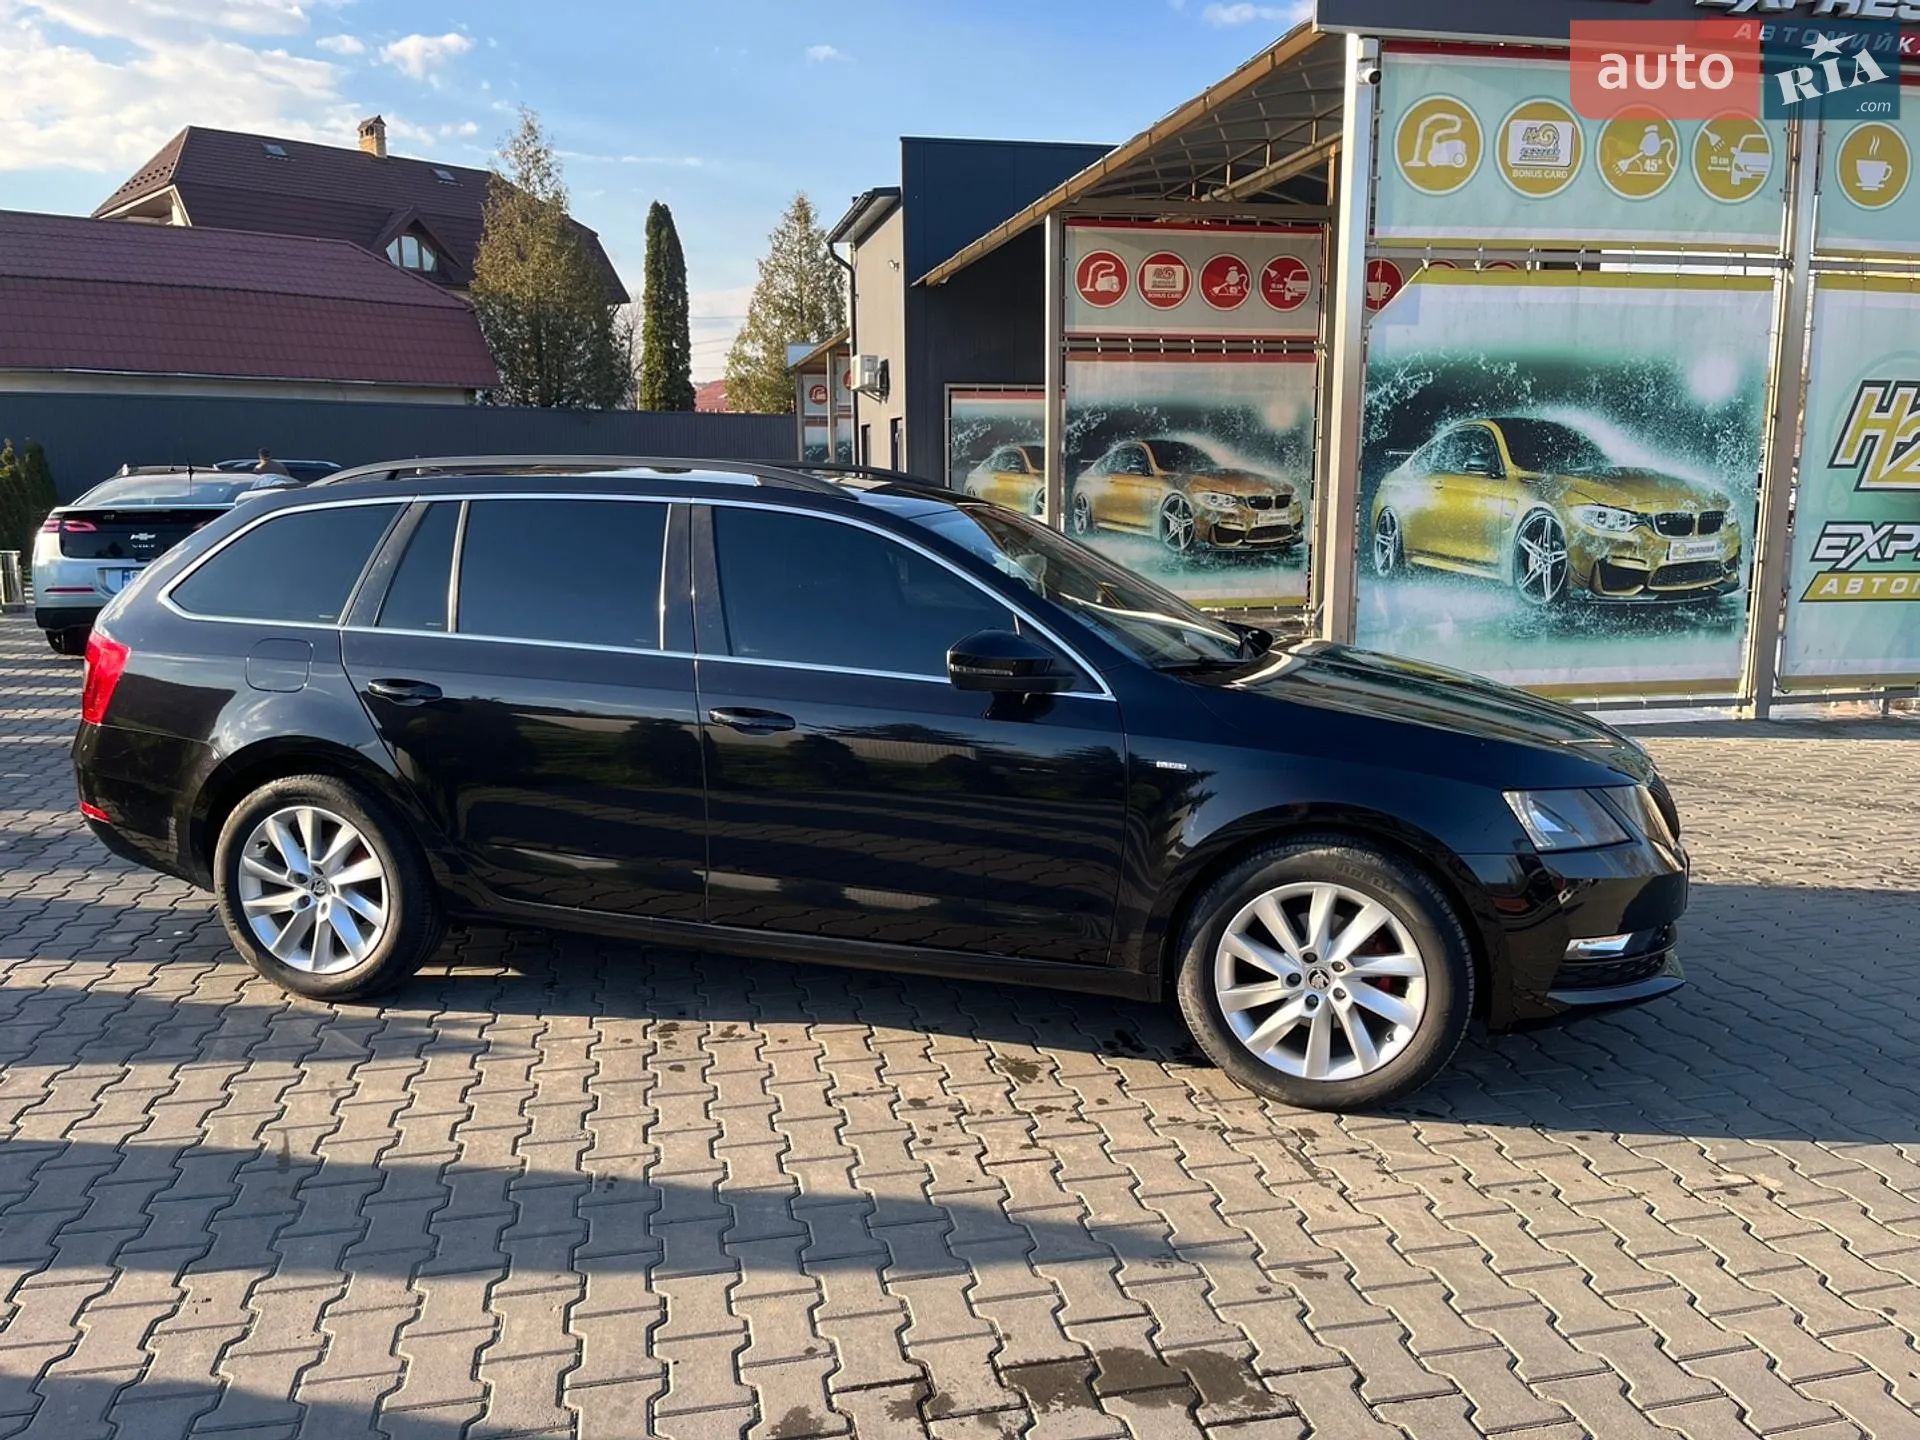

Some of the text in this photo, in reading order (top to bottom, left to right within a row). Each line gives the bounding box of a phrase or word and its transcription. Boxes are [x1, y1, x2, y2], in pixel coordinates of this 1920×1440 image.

[1512, 169, 1568, 179] BONUS CARD
[1810, 521, 1920, 572] EXP
